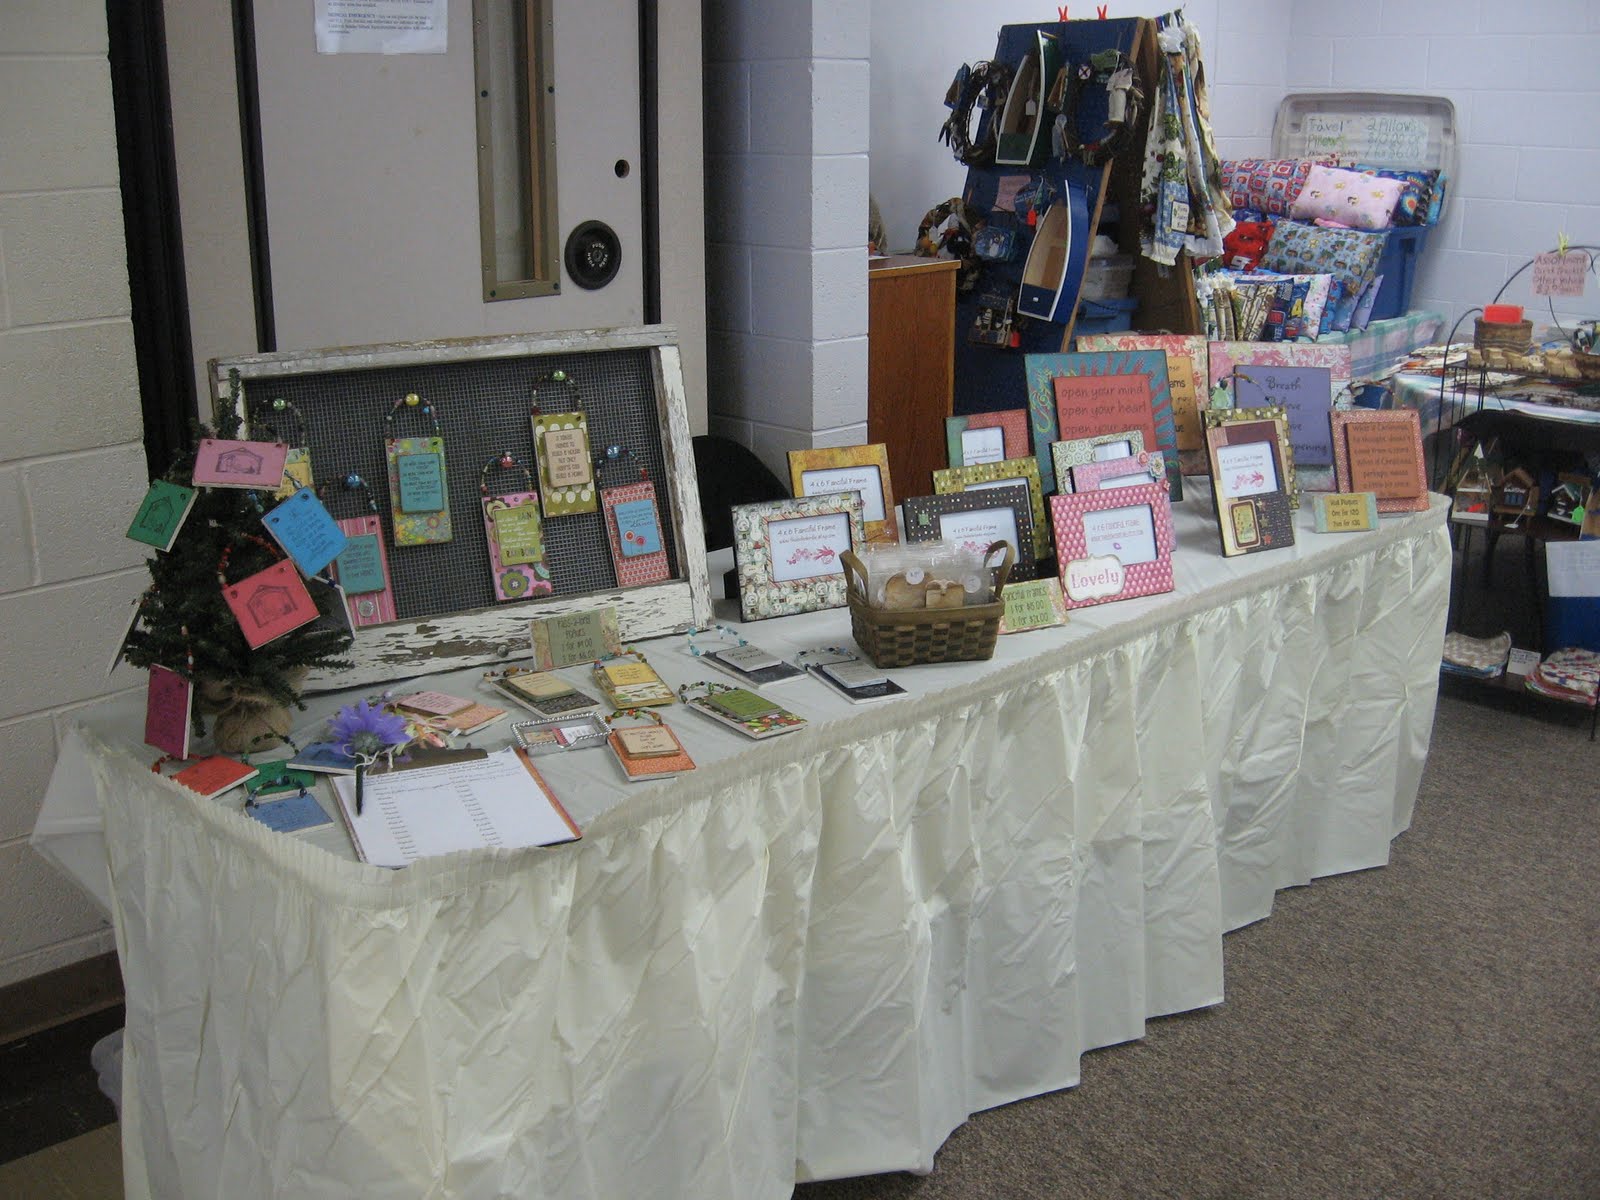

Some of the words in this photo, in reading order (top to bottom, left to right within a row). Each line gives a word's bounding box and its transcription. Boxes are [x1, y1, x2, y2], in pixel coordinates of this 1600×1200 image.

[1309, 118, 1344, 132] Travel
[1061, 388, 1088, 398] open
[1090, 386, 1114, 399] your
[1118, 383, 1143, 395] mind
[1062, 405, 1088, 417] open
[1091, 404, 1115, 418] your
[1118, 400, 1146, 413] heart
[1064, 425, 1091, 436] open
[1071, 568, 1120, 589] Lovely
